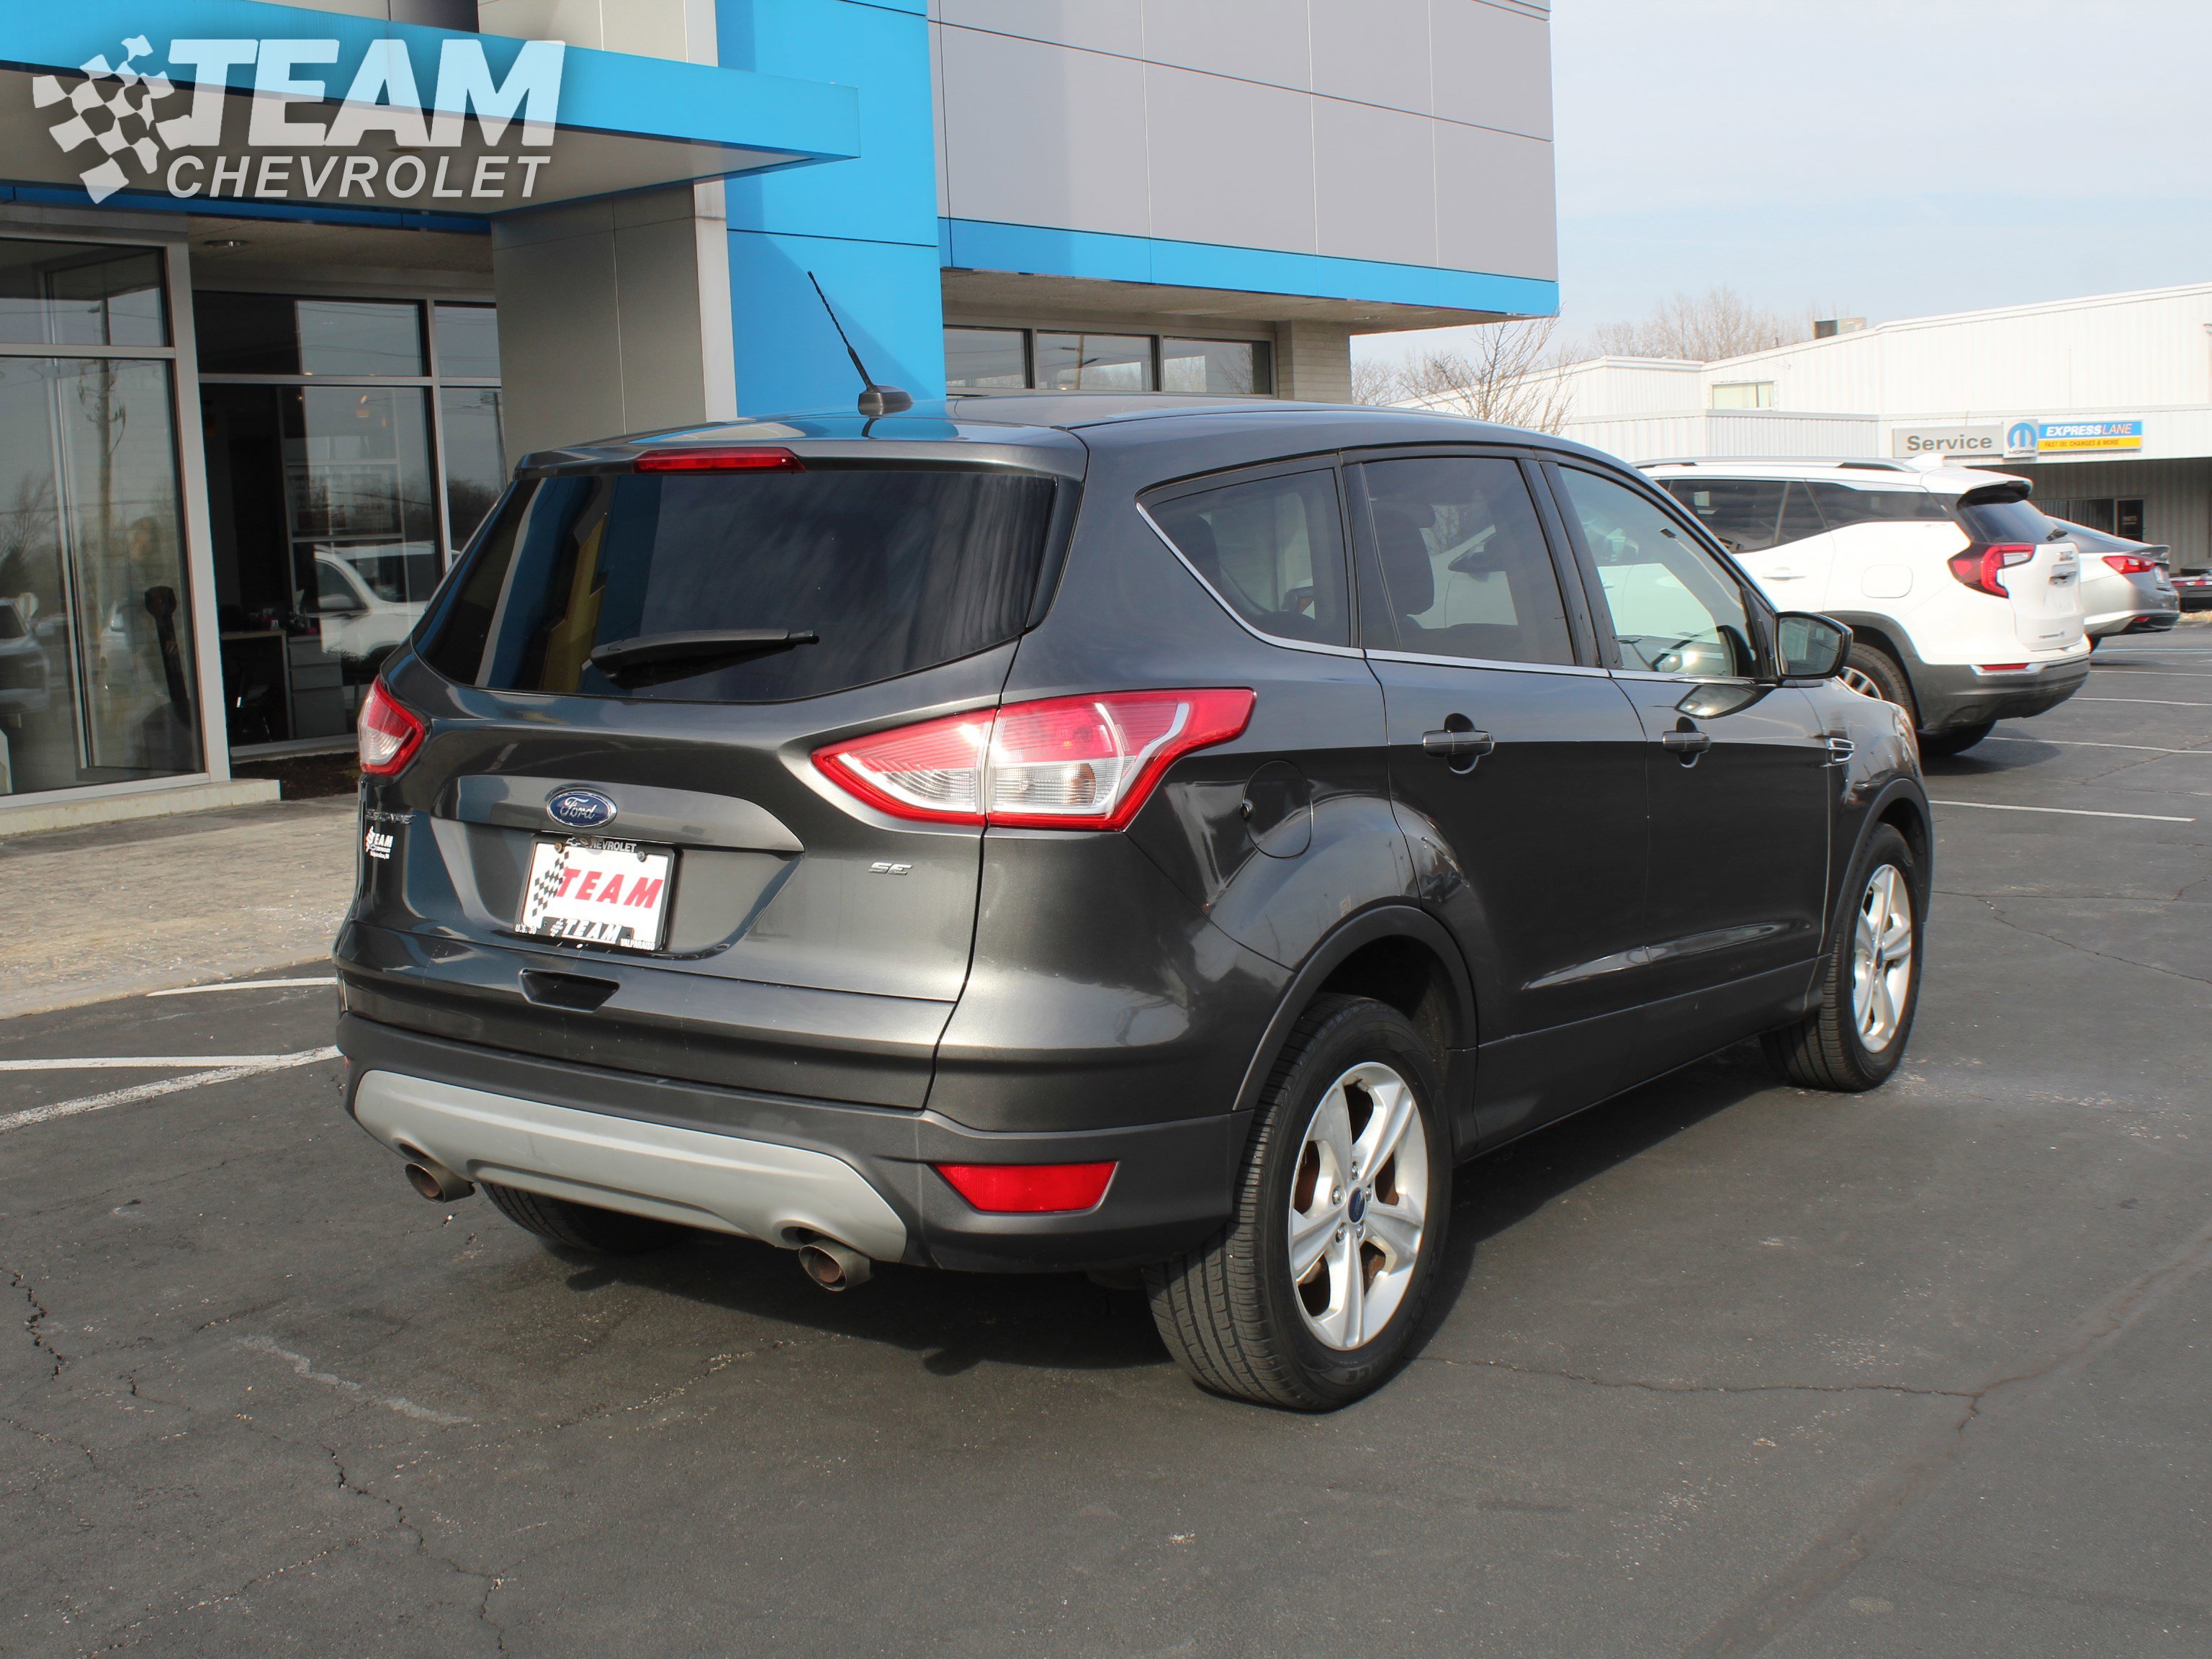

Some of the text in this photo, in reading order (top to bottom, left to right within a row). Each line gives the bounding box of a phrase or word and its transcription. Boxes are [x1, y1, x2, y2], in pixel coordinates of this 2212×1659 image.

[1907, 434, 1992, 451] Service
[559, 796, 598, 819] Ford
[868, 862, 912, 876] SE
[556, 868, 664, 909] TEAM
[562, 917, 623, 942] TEAM
[620, 938, 655, 950] VALPARAISO
